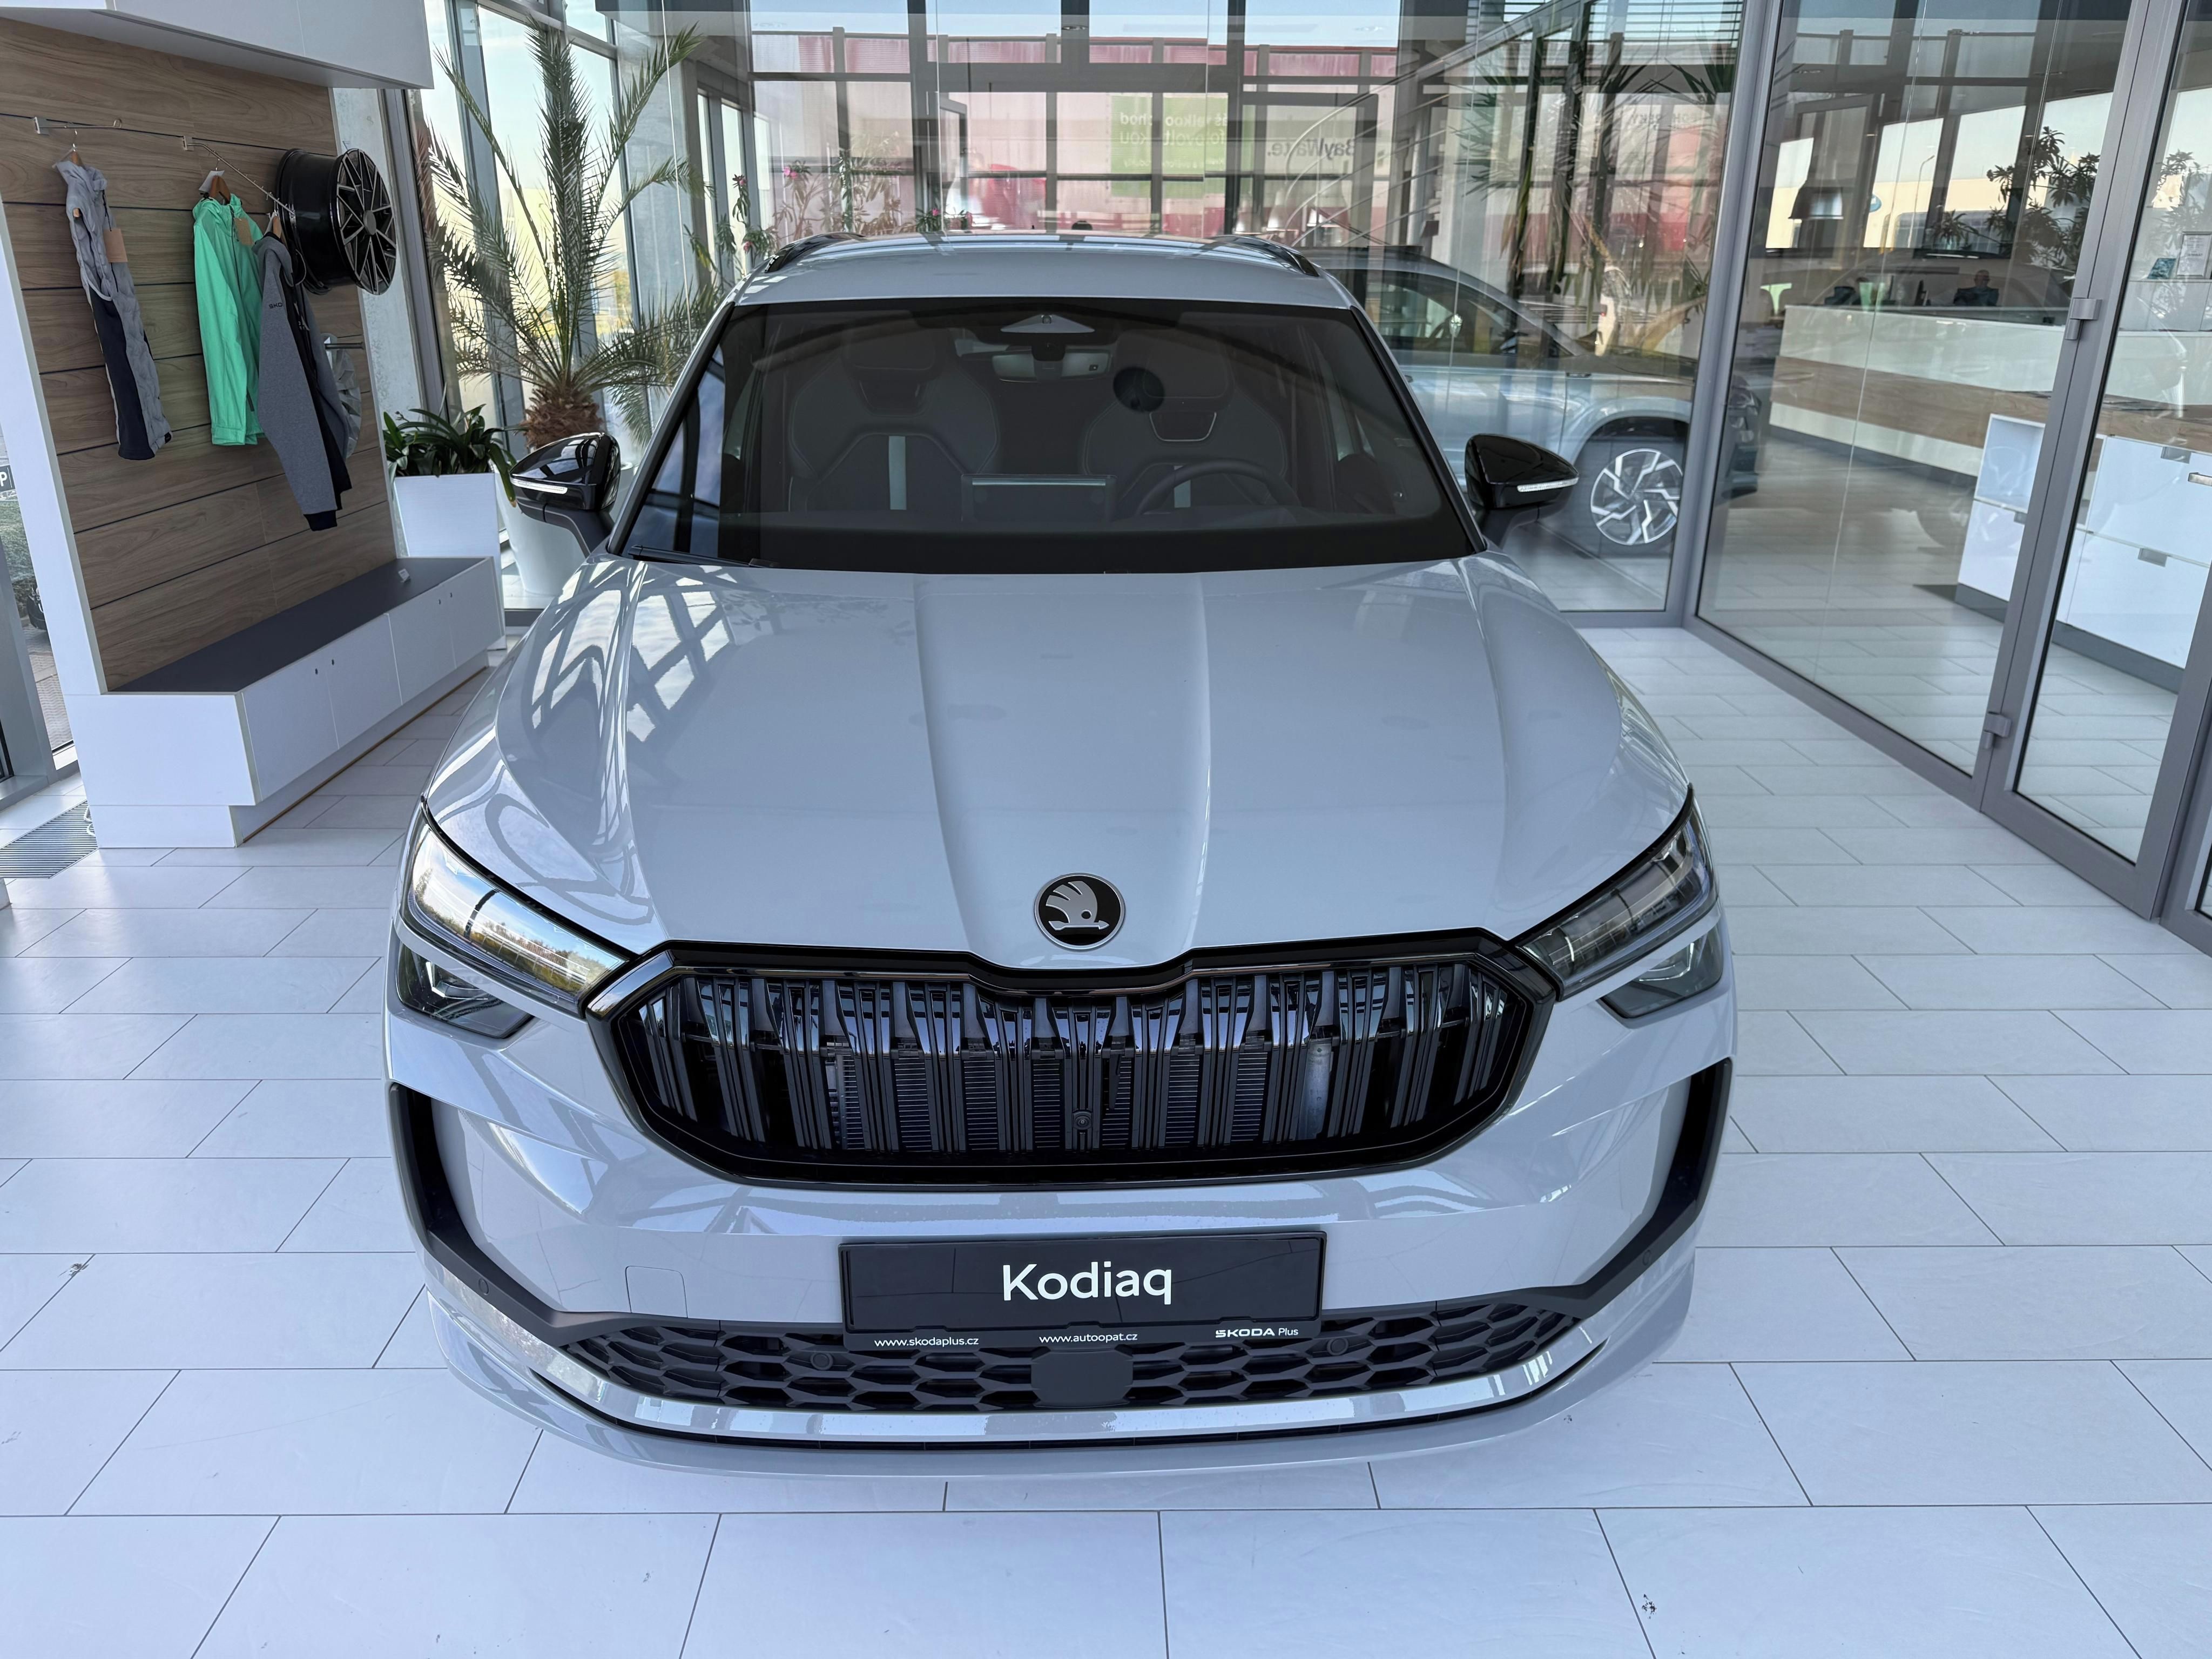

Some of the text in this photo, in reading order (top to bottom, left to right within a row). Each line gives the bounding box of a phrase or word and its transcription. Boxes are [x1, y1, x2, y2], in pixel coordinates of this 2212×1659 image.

[1003, 1261, 1171, 1305] Kodiaq
[1278, 1328, 1298, 1336] Plus
[874, 1337, 979, 1347] www.skodaplus.cz
[1038, 1333, 1138, 1343] www.autoopat.cz
